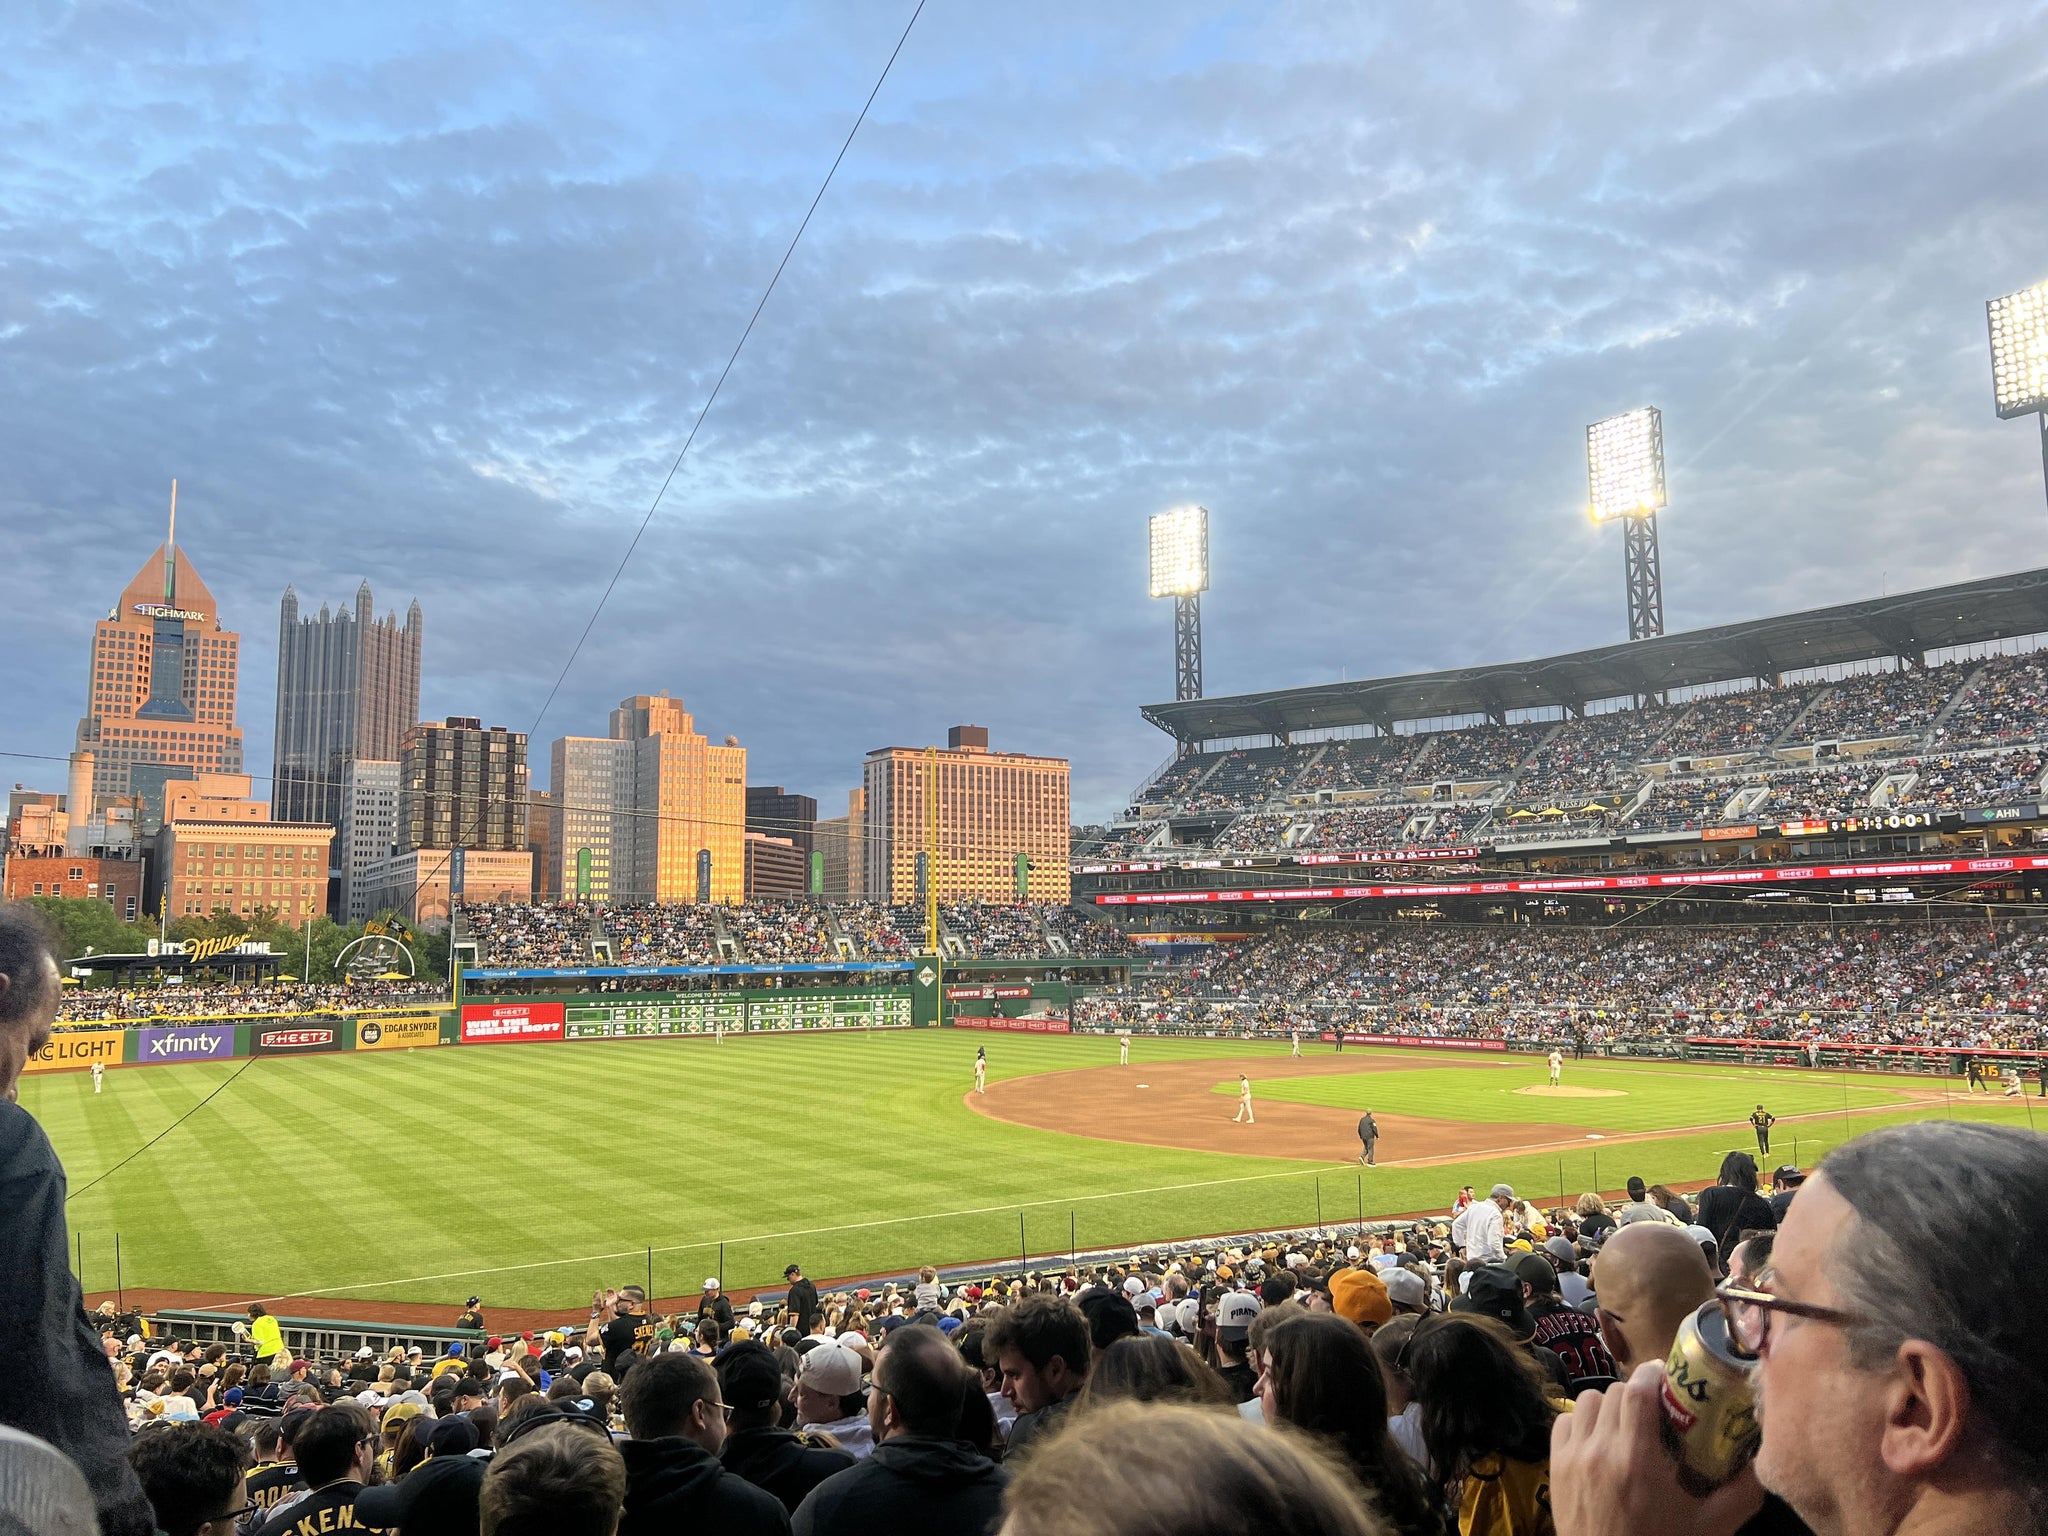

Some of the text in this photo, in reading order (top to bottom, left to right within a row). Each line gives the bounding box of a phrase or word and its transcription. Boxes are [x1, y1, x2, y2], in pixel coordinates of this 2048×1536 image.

[141, 606, 204, 622] HIGHMARK
[1560, 800, 1594, 809] RESERVE
[1996, 808, 2020, 818] AHN
[1889, 815, 1900, 829] 0
[1905, 814, 1916, 828] 0
[1923, 813, 1930, 826] 1
[1716, 828, 1730, 836] PNC
[1778, 870, 1812, 878] SHEETZ
[1877, 865, 1920, 873] SHEETZ
[1920, 864, 1952, 872] NOT?
[1970, 860, 2012, 868] SHEETZ
[162, 934, 270, 964] IT'S Miller TIME
[494, 1008, 528, 1016] SHEETZ
[384, 1022, 438, 1032] EDGAR SNYDER
[466, 1018, 529, 1028] WHY THE
[466, 1024, 560, 1036] SHEETZ NOT?
[150, 1032, 222, 1056] xfinity
[266, 1032, 328, 1044] SHEETZ
[58, 1040, 116, 1058] LIGHT
[1988, 1065, 1998, 1076] 15
[1230, 1307, 1258, 1320] PIRATE
[1535, 1312, 1598, 1345] GRIFFEY
[254, 1485, 293, 1510] BON
